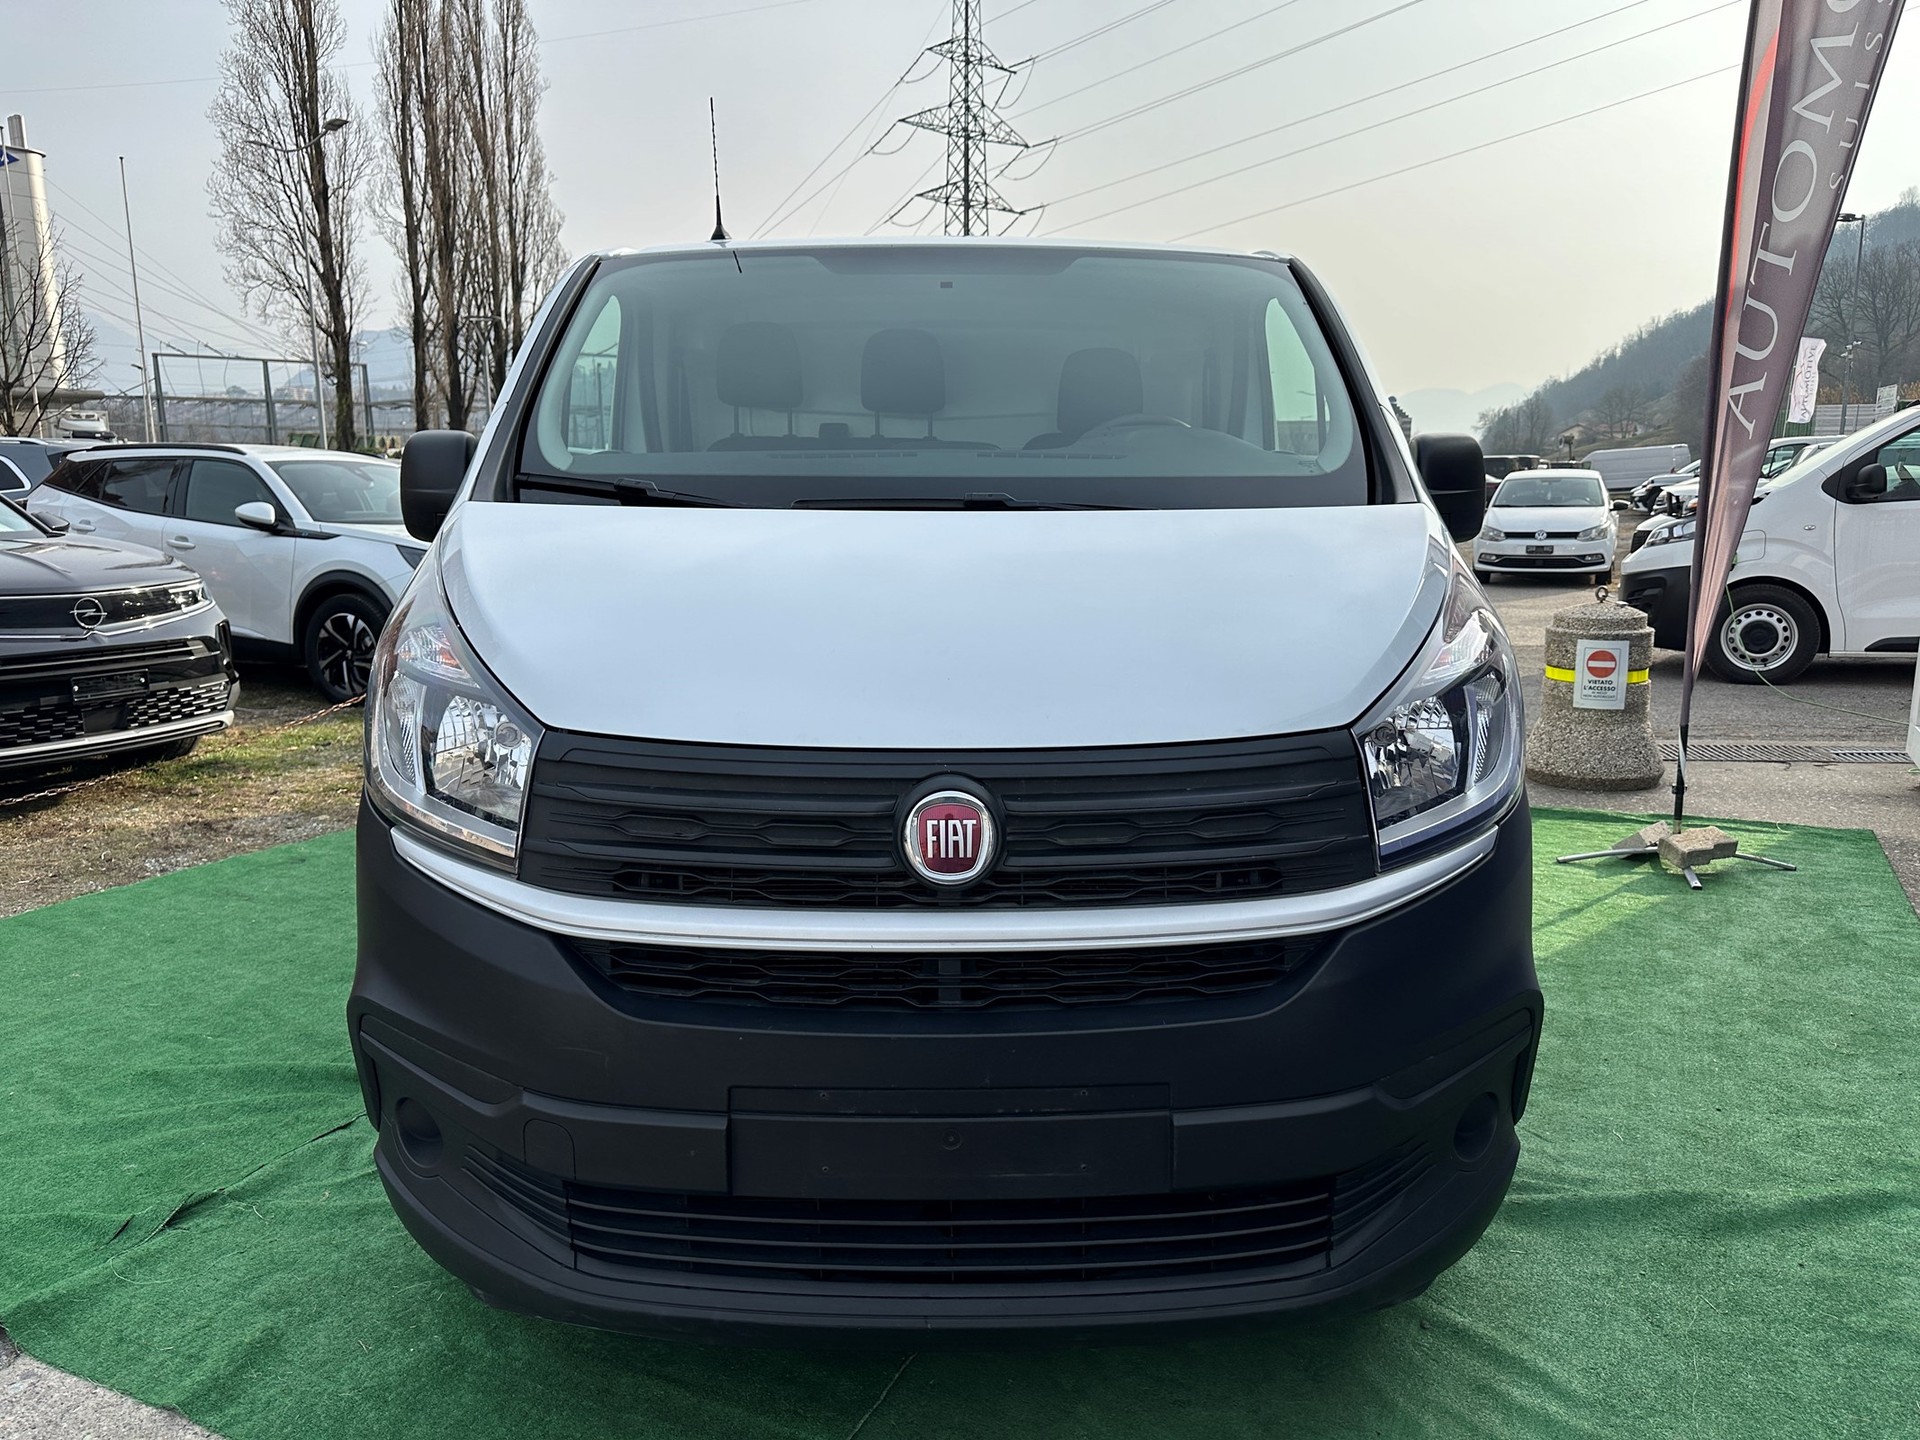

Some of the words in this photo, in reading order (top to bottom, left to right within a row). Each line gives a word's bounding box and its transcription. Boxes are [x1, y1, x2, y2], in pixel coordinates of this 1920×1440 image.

[1830, 0, 1893, 194] SUIS
[1728, 0, 1860, 440] AUTOM
[926, 819, 977, 858] FIAT
